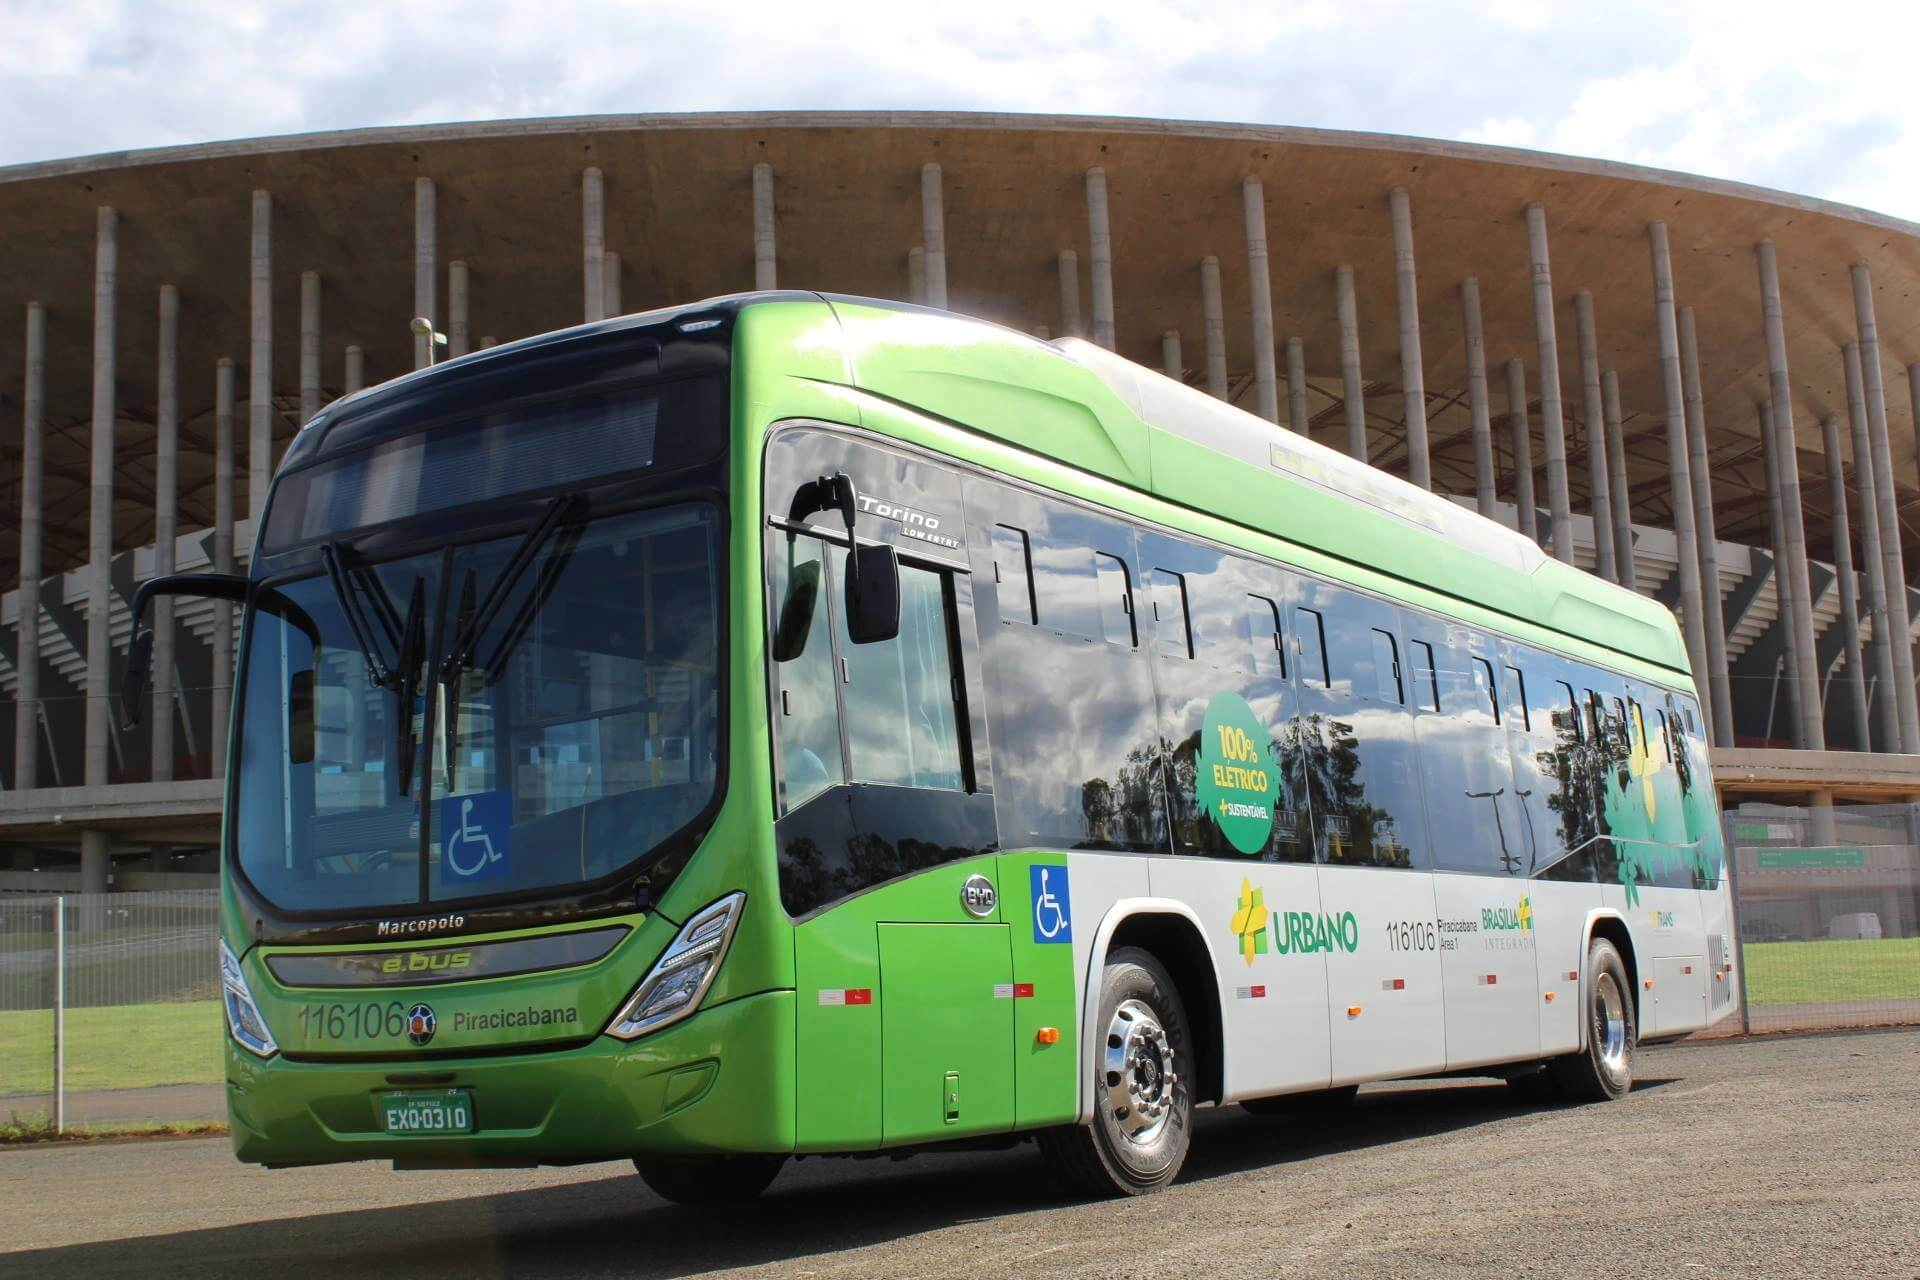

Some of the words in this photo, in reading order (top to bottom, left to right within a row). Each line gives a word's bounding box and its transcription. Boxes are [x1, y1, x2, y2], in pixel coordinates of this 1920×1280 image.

[858, 495, 939, 529] Torino
[903, 526, 926, 539] LOW
[927, 533, 960, 549] ENTRY
[1217, 724, 1258, 764] 100%
[1213, 760, 1268, 793] ELÉTRICO
[966, 887, 994, 906] BYD
[377, 914, 465, 936] Marcopolo
[1273, 911, 1359, 955] URBANO
[1386, 920, 1435, 951] 116106
[1437, 919, 1478, 933] Piracicabana
[297, 1001, 405, 1040] 116106
[453, 1006, 578, 1032] Piracicabana
